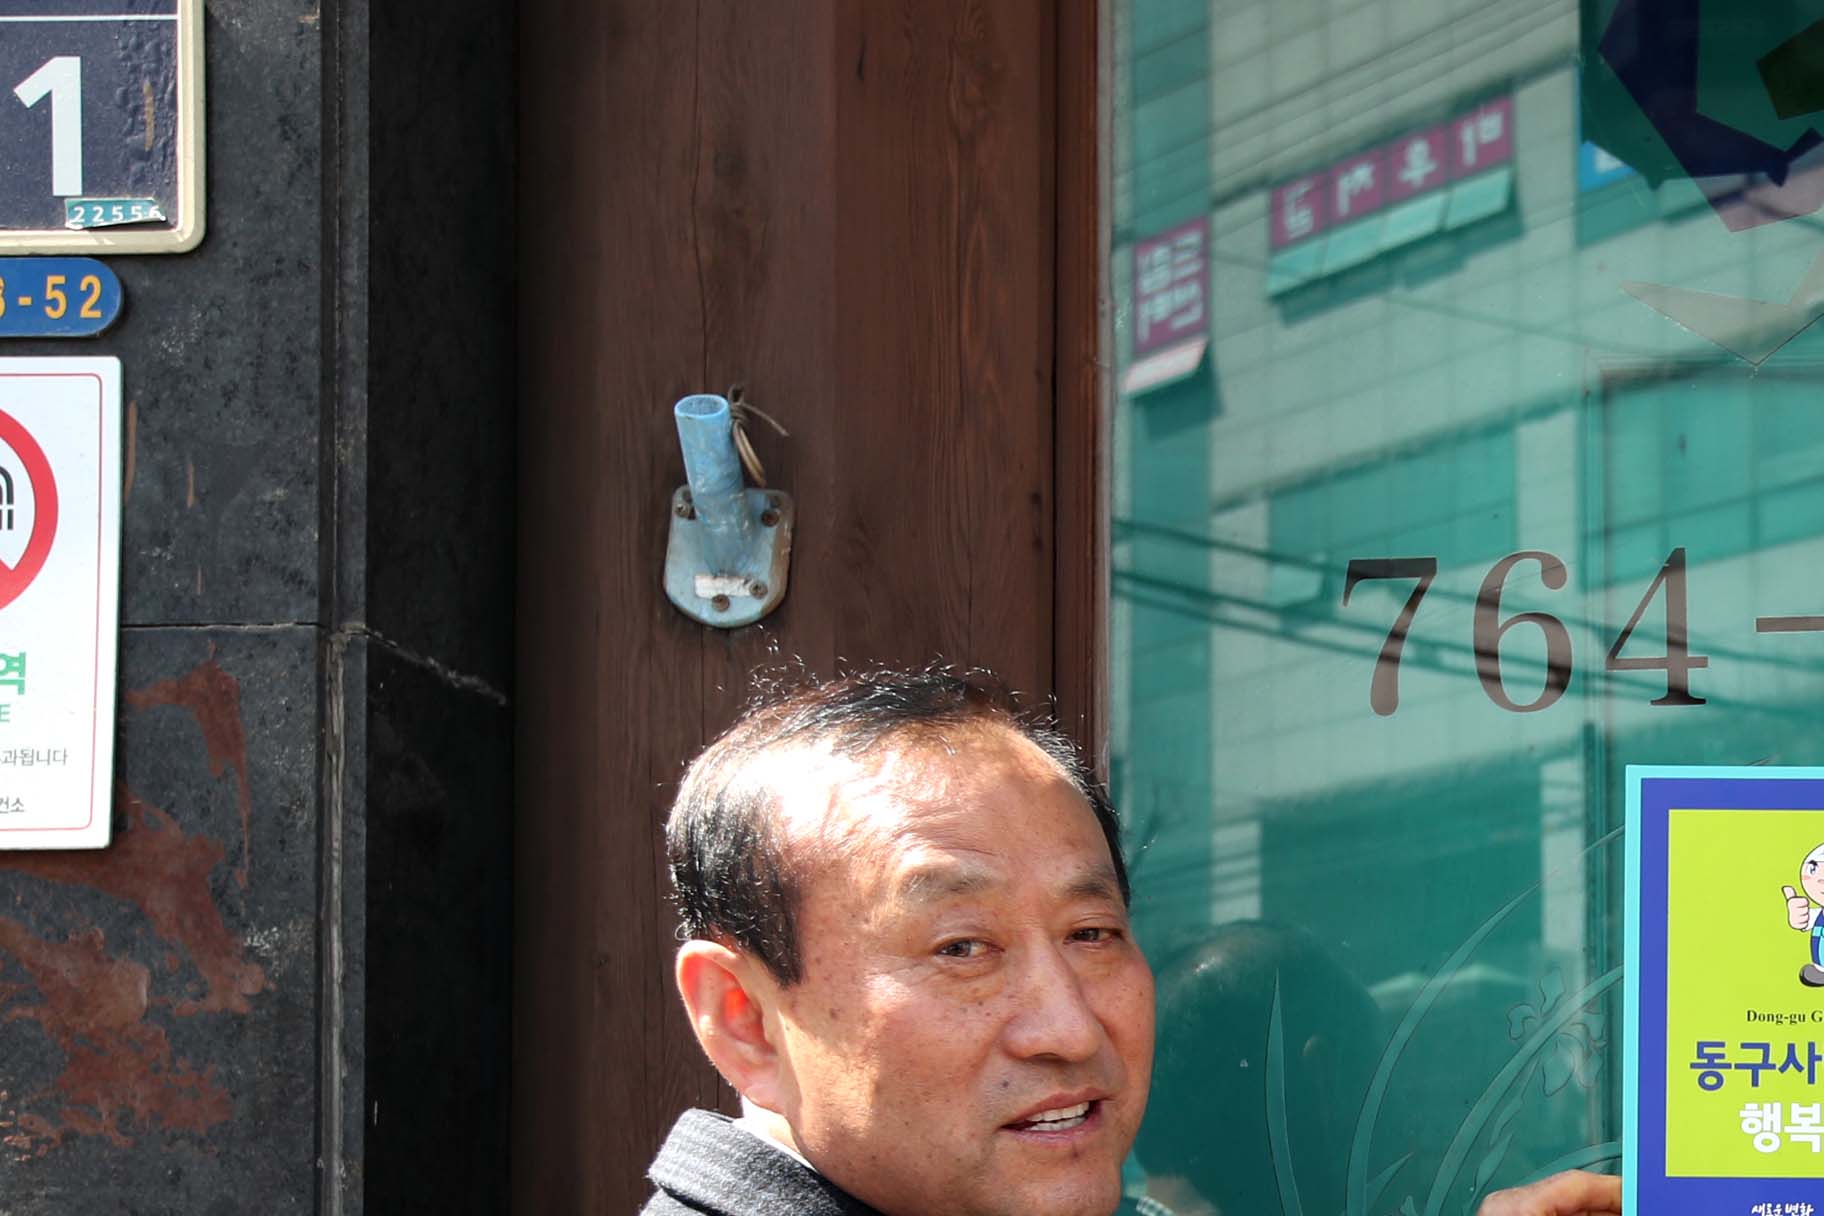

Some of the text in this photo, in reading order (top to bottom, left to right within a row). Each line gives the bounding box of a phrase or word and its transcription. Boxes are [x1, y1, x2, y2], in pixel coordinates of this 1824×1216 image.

[13, 56, 82, 196] 1
[0, 274, 102, 319] -52
[1746, 1010, 1806, 1025] Dong-gu
